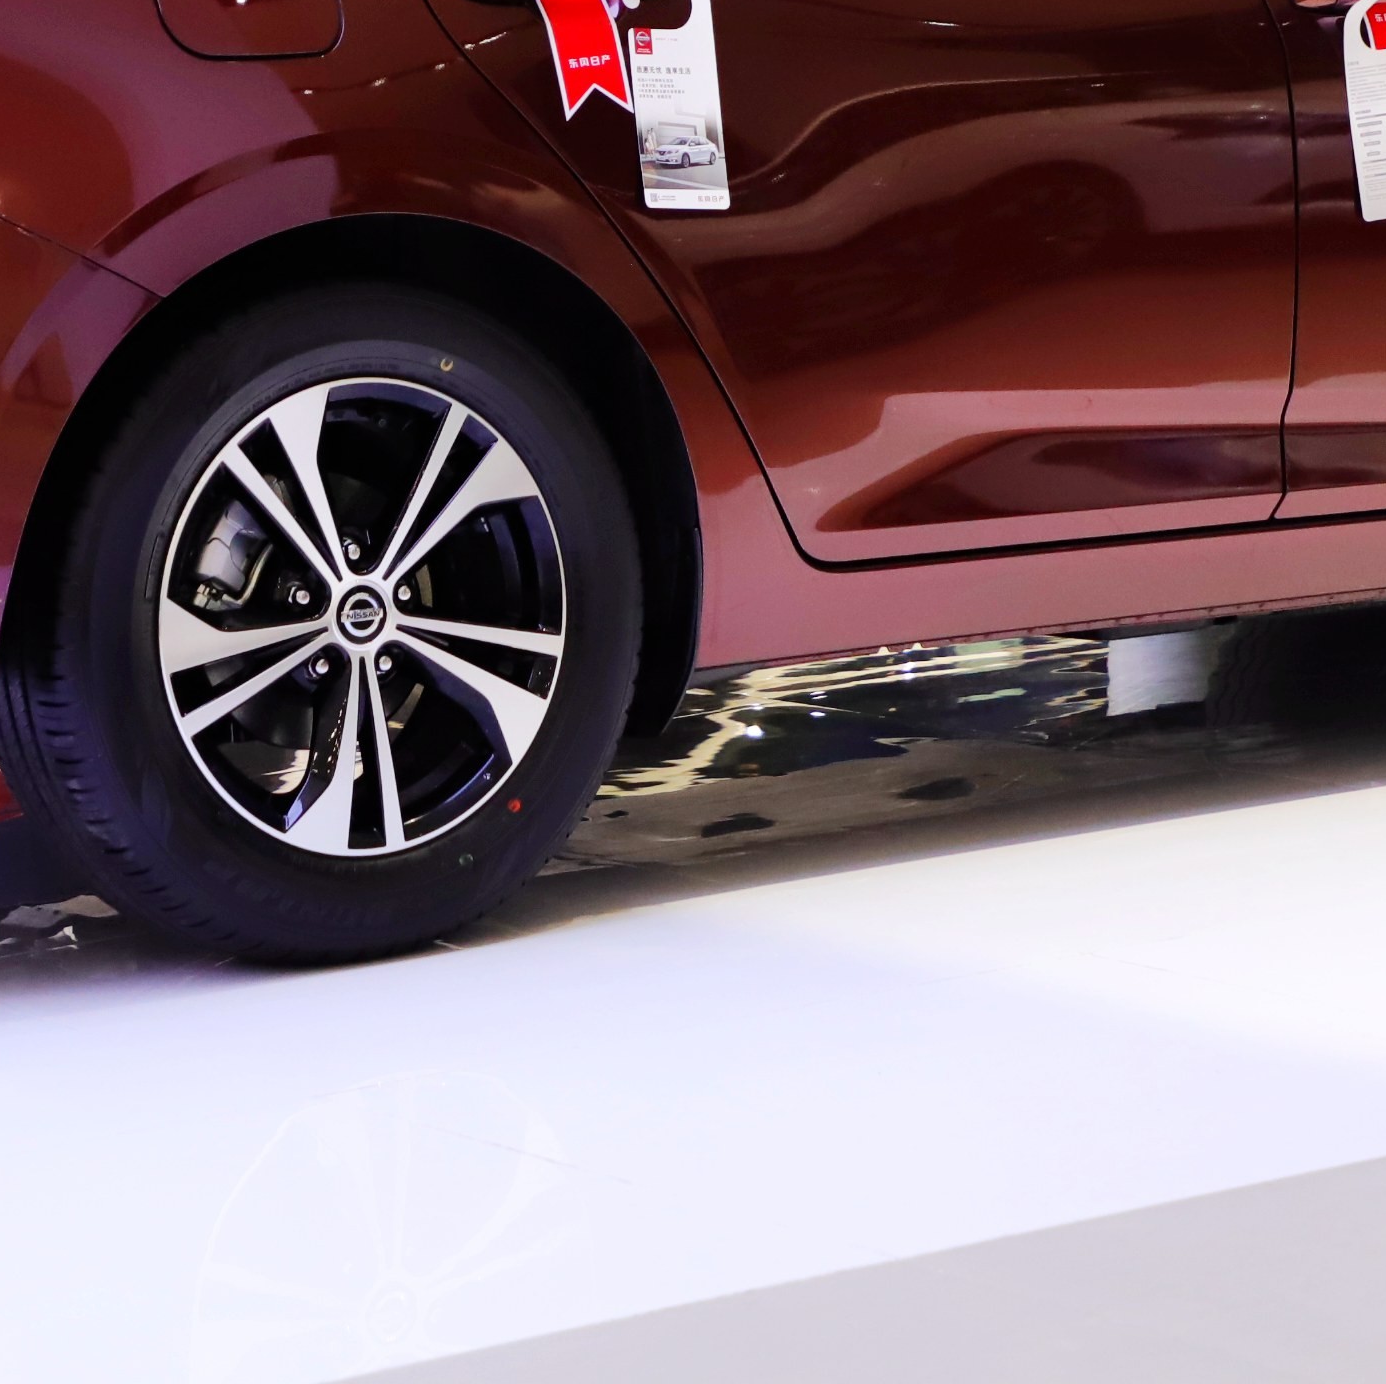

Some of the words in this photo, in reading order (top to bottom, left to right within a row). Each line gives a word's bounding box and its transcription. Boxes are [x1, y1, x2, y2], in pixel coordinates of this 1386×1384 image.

[568, 54, 611, 69] 东风日产
[346, 610, 381, 620] NISSAN
